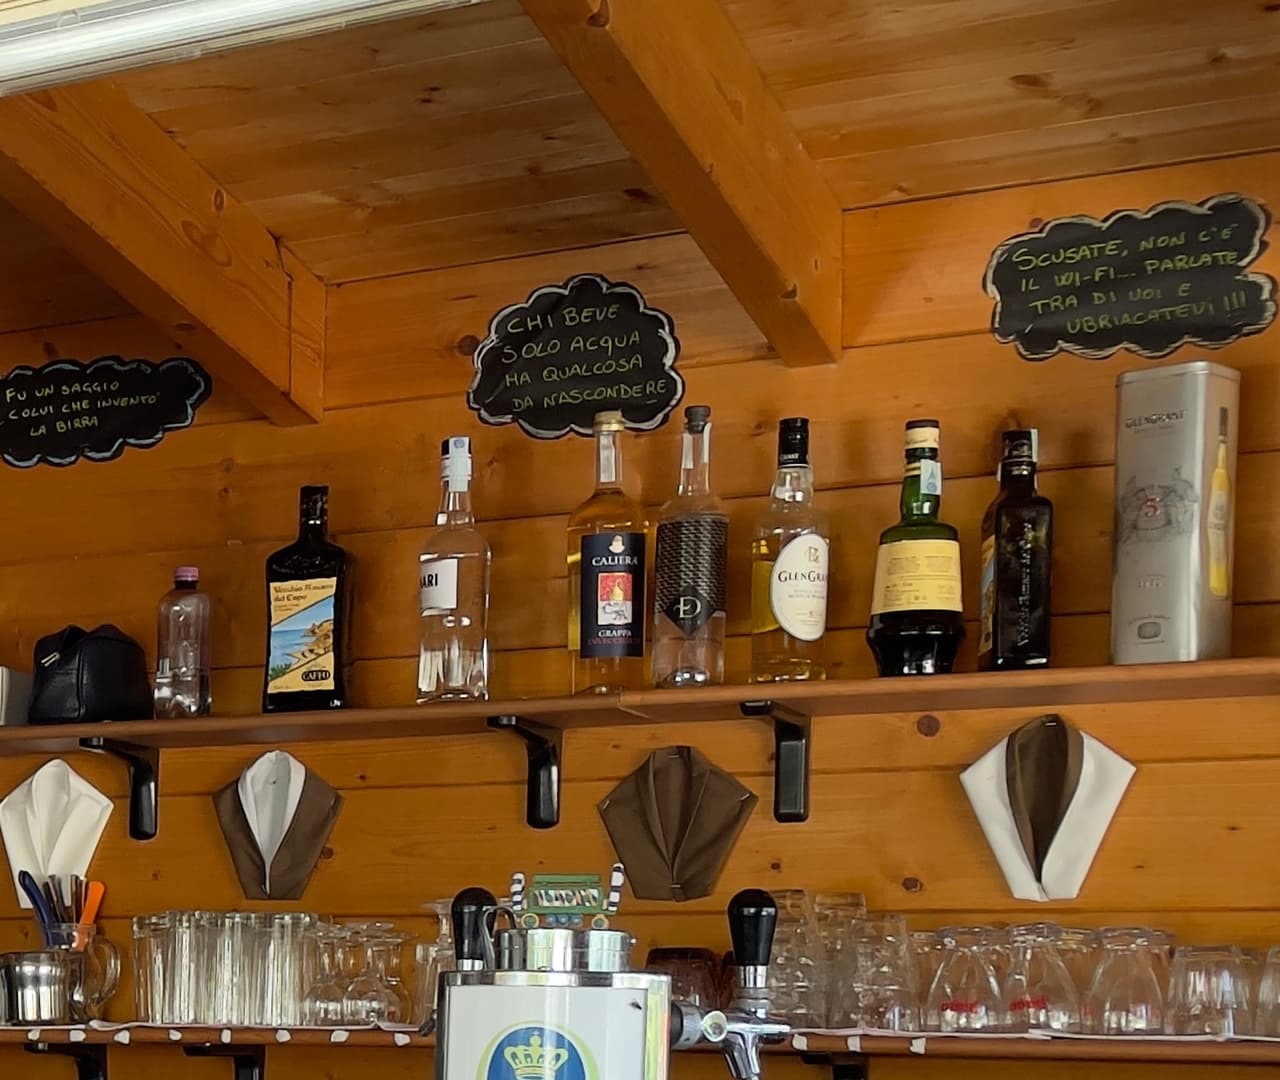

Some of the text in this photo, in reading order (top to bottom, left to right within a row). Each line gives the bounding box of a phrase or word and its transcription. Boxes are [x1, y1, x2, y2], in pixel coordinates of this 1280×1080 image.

[1139, 231, 1185, 251] NON
[1021, 277, 1039, 292] IL
[1144, 251, 1239, 275] PARLATE
[1029, 296, 1078, 316] TRA
[1093, 290, 1116, 305] DI
[1178, 282, 1192, 296] E
[507, 304, 620, 333] CHI BEVE
[501, 339, 561, 364] SOLO
[505, 354, 643, 387] HA QUALCOSA
[36, 384, 54, 398] UN
[61, 381, 120, 396] SAGGIO
[512, 379, 667, 411] DA NASCONDERE
[8, 407, 54, 420] COLUI
[62, 400, 90, 413] CHE
[30, 416, 99, 436] LA BIRRA
[592, 555, 638, 566] CALIERA
